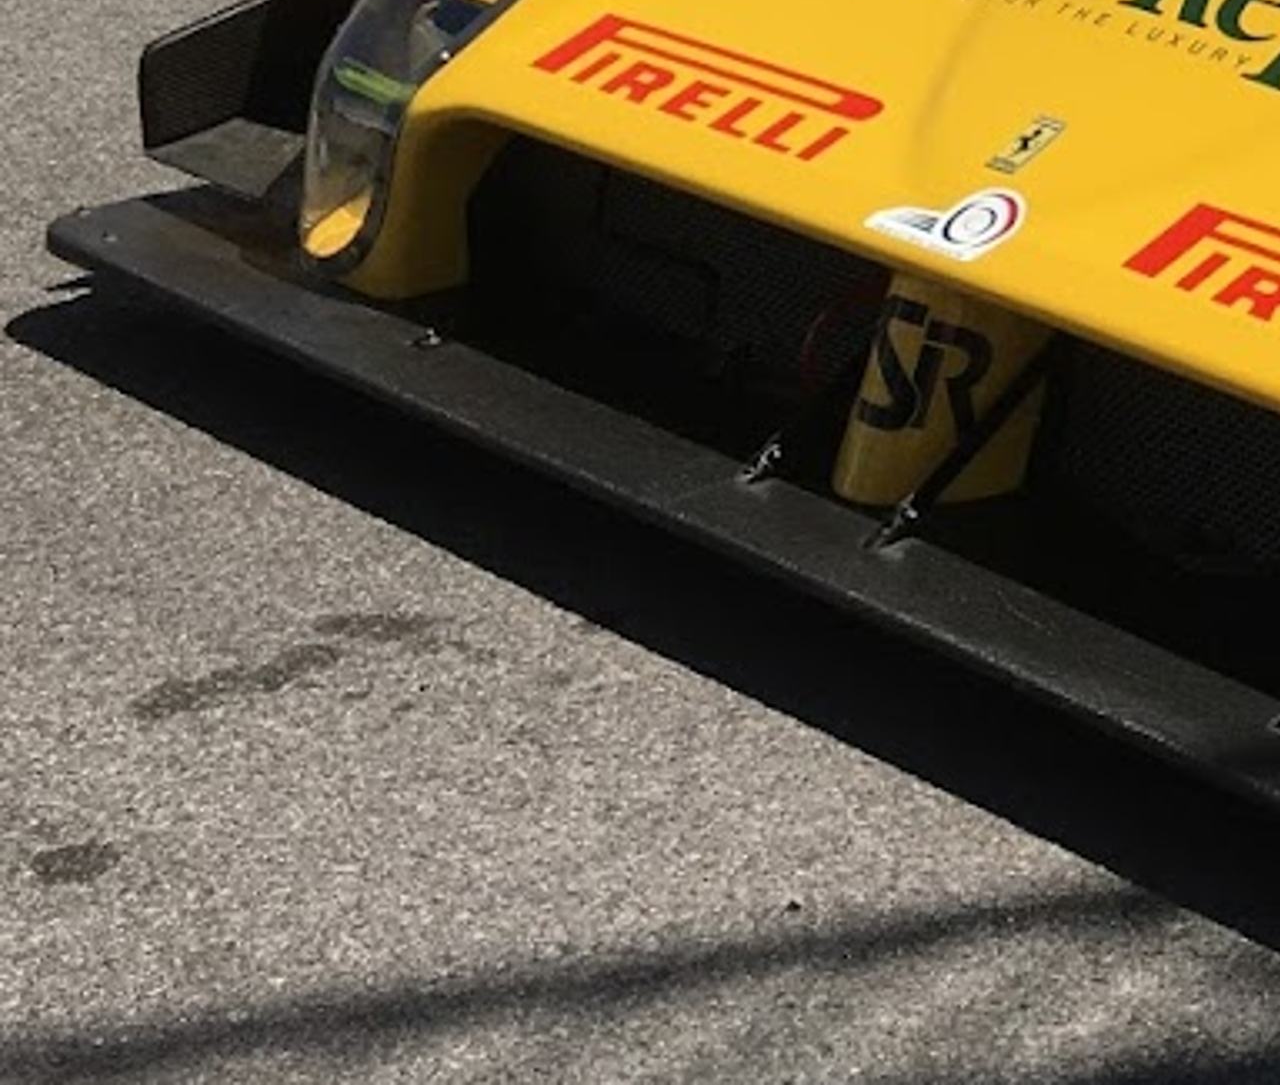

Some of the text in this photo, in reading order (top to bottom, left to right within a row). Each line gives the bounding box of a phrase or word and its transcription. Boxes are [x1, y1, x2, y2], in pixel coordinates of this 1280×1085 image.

[529, 12, 886, 162] PIRELLI
[1057, 0, 1110, 28] THE
[1126, 20, 1255, 70] LUXURY
